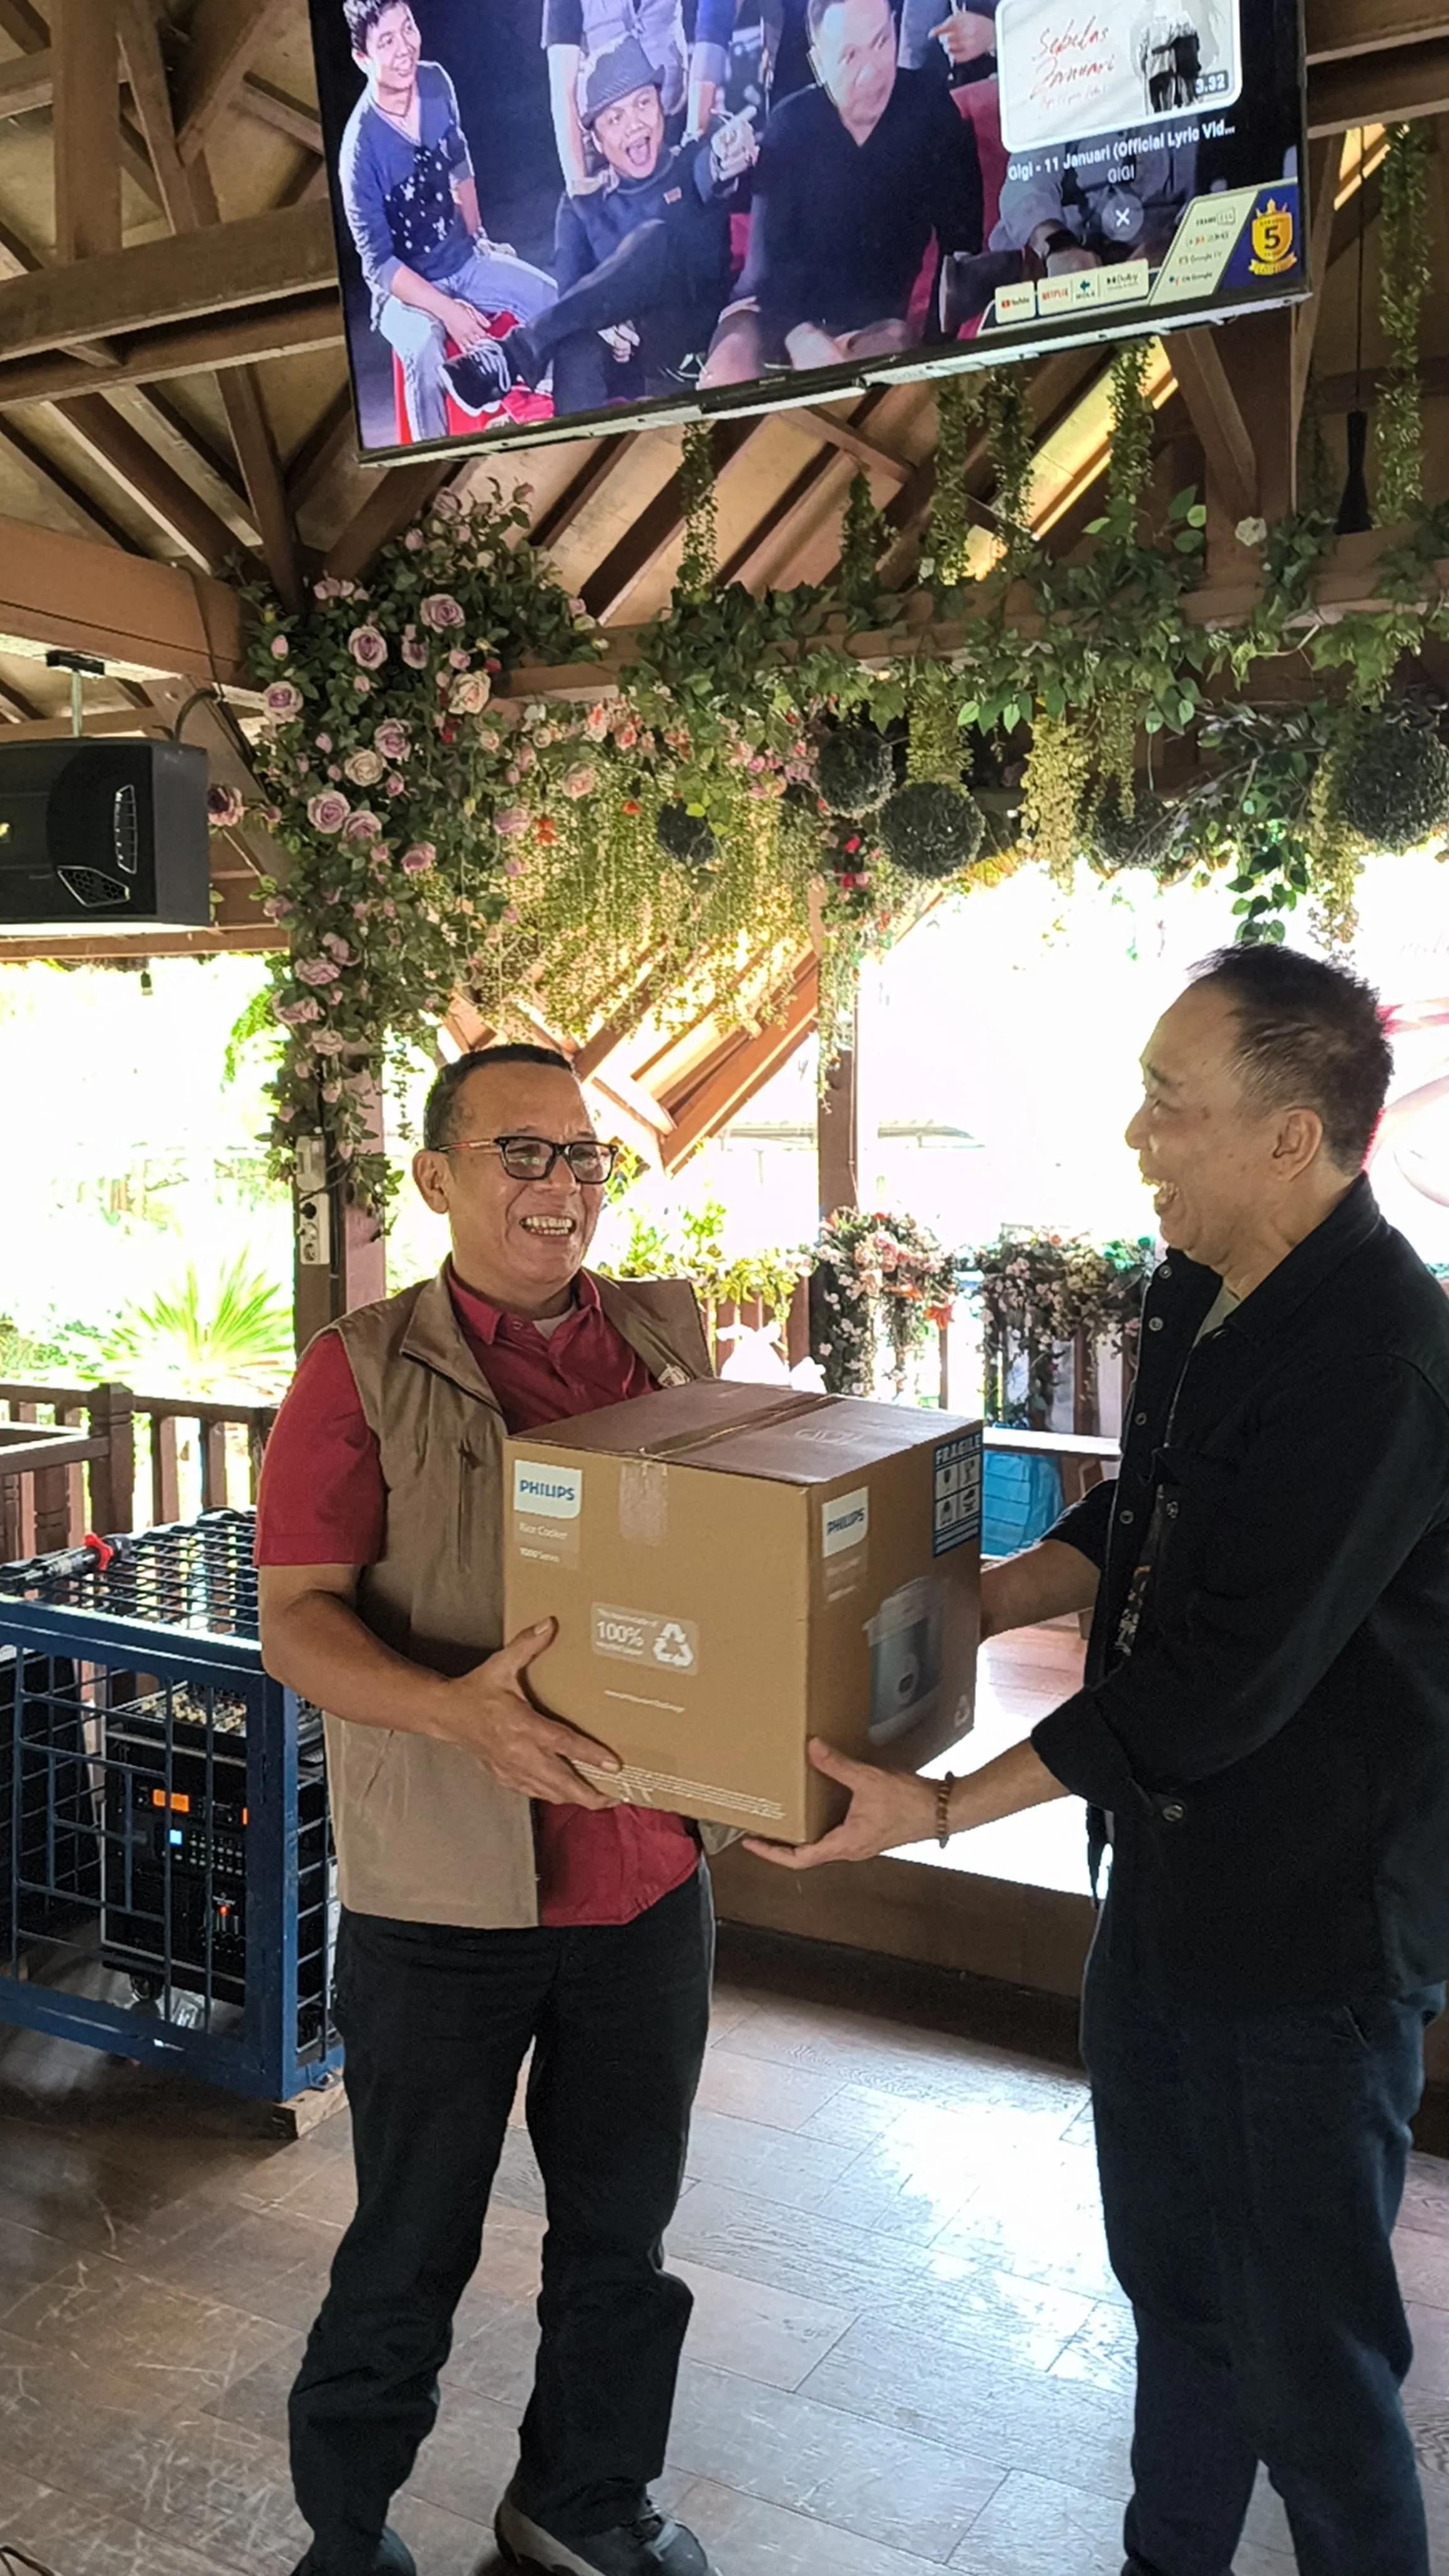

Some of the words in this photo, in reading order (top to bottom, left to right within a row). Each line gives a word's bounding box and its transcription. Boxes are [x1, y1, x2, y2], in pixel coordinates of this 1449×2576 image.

[1044, 157, 1058, 174] 11
[1063, 147, 1111, 169] Januari
[1113, 133, 1164, 158] (Official
[1168, 126, 1199, 148] Lyric
[1107, 165, 1135, 184] GIGI
[1264, 225, 1280, 249] 5
[936, 1433, 981, 1465] FRAGILE
[519, 1480, 575, 1501] PHILIPS
[826, 1507, 865, 1536] PHILIPS
[597, 1620, 644, 1647] 100%
